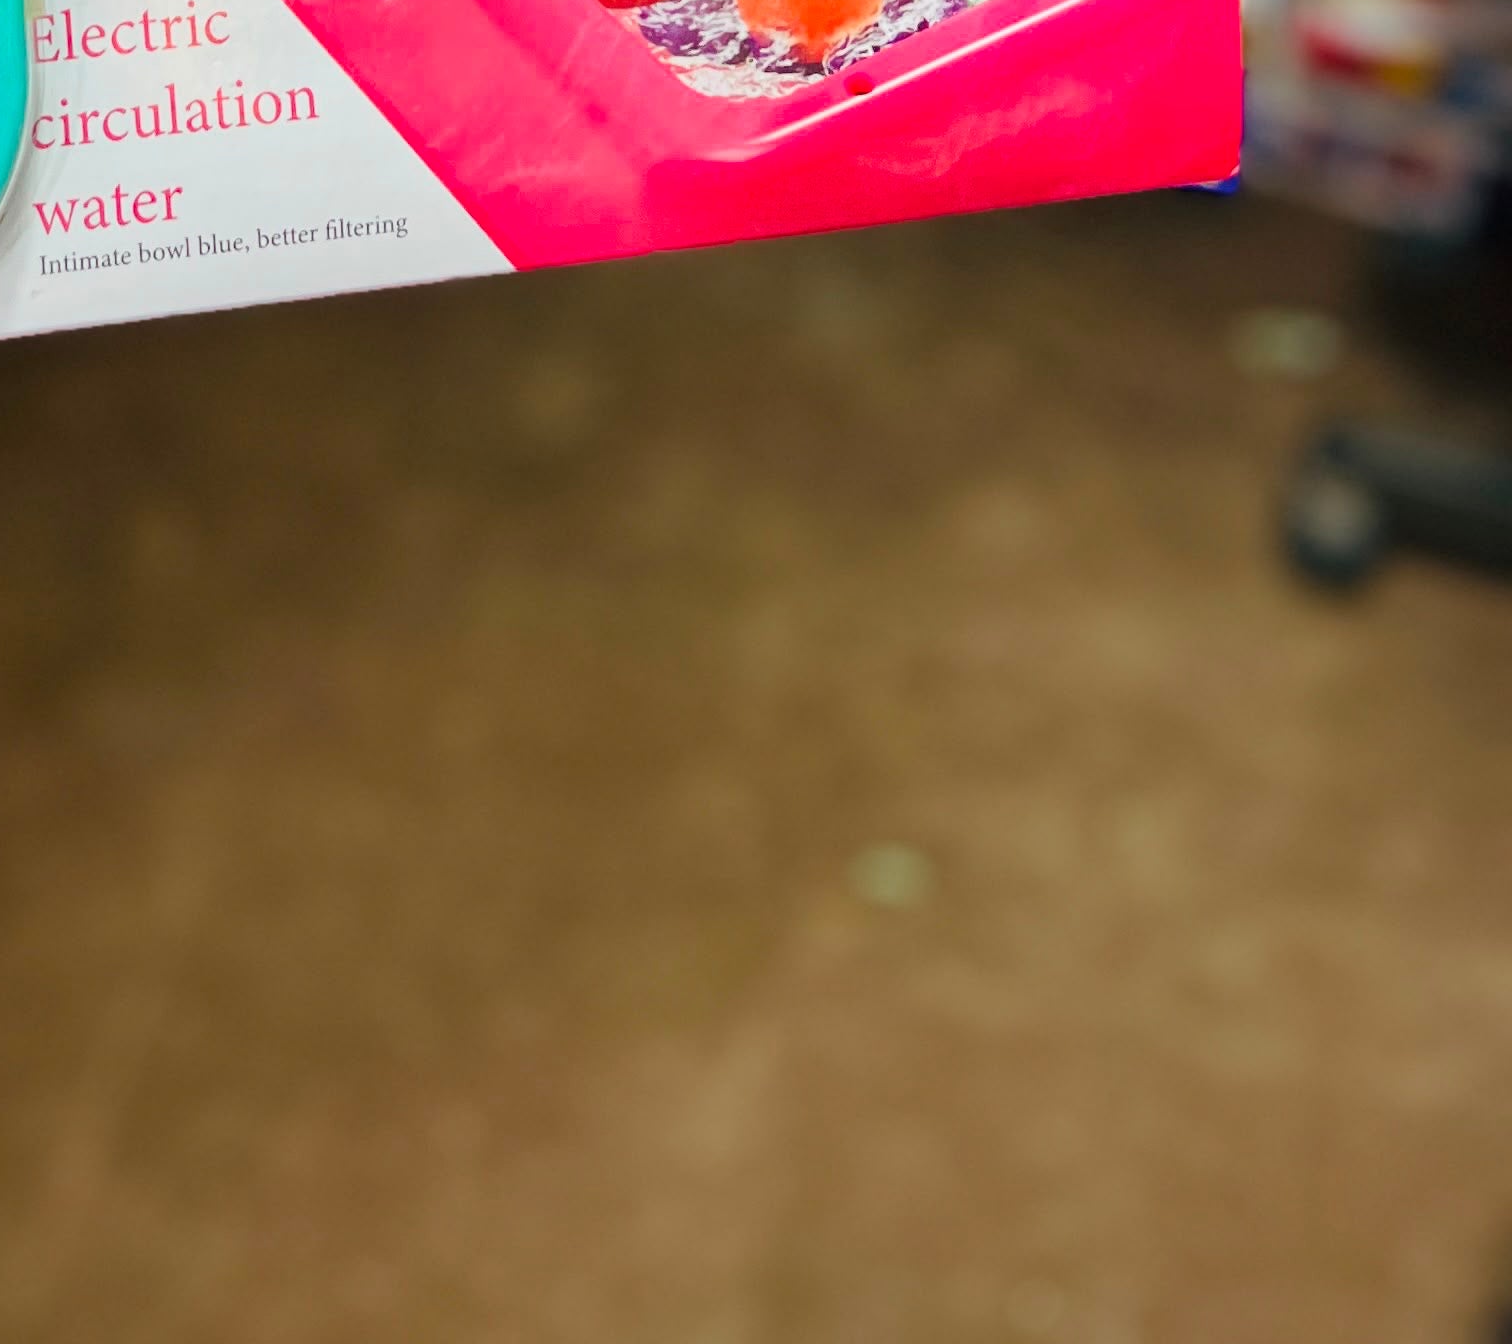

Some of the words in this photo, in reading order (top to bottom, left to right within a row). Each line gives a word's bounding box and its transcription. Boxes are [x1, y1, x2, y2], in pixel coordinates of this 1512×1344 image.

[32, 0, 231, 64] Electric
[31, 79, 320, 150] circulation
[32, 183, 184, 235] water
[39, 249, 132, 276] Intimate
[138, 237, 190, 265] bowl
[198, 233, 250, 256] blue,
[256, 226, 319, 250] better
[325, 215, 409, 243] filtering
